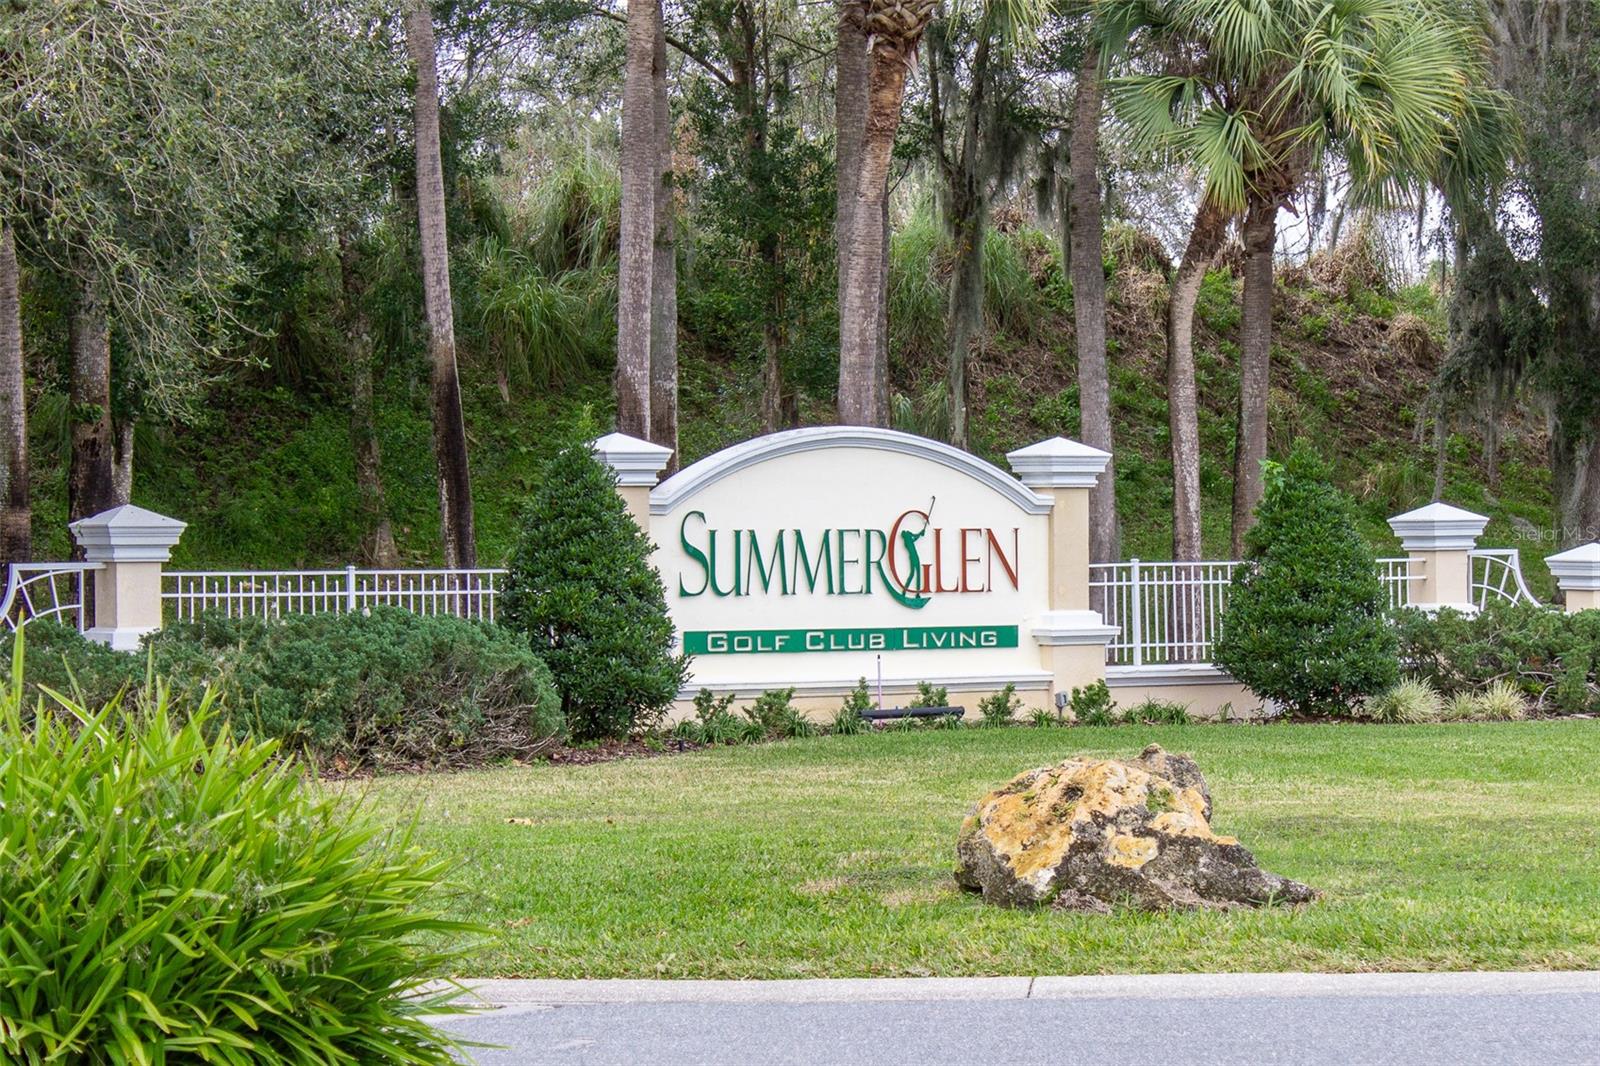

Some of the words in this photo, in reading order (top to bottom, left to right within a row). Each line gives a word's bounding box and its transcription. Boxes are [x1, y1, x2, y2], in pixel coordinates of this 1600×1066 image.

[679, 510, 1019, 609] SUMMERGLEN
[707, 632, 790, 652] GOLF
[805, 631, 886, 651] CLUB
[903, 629, 998, 649] LIVING
